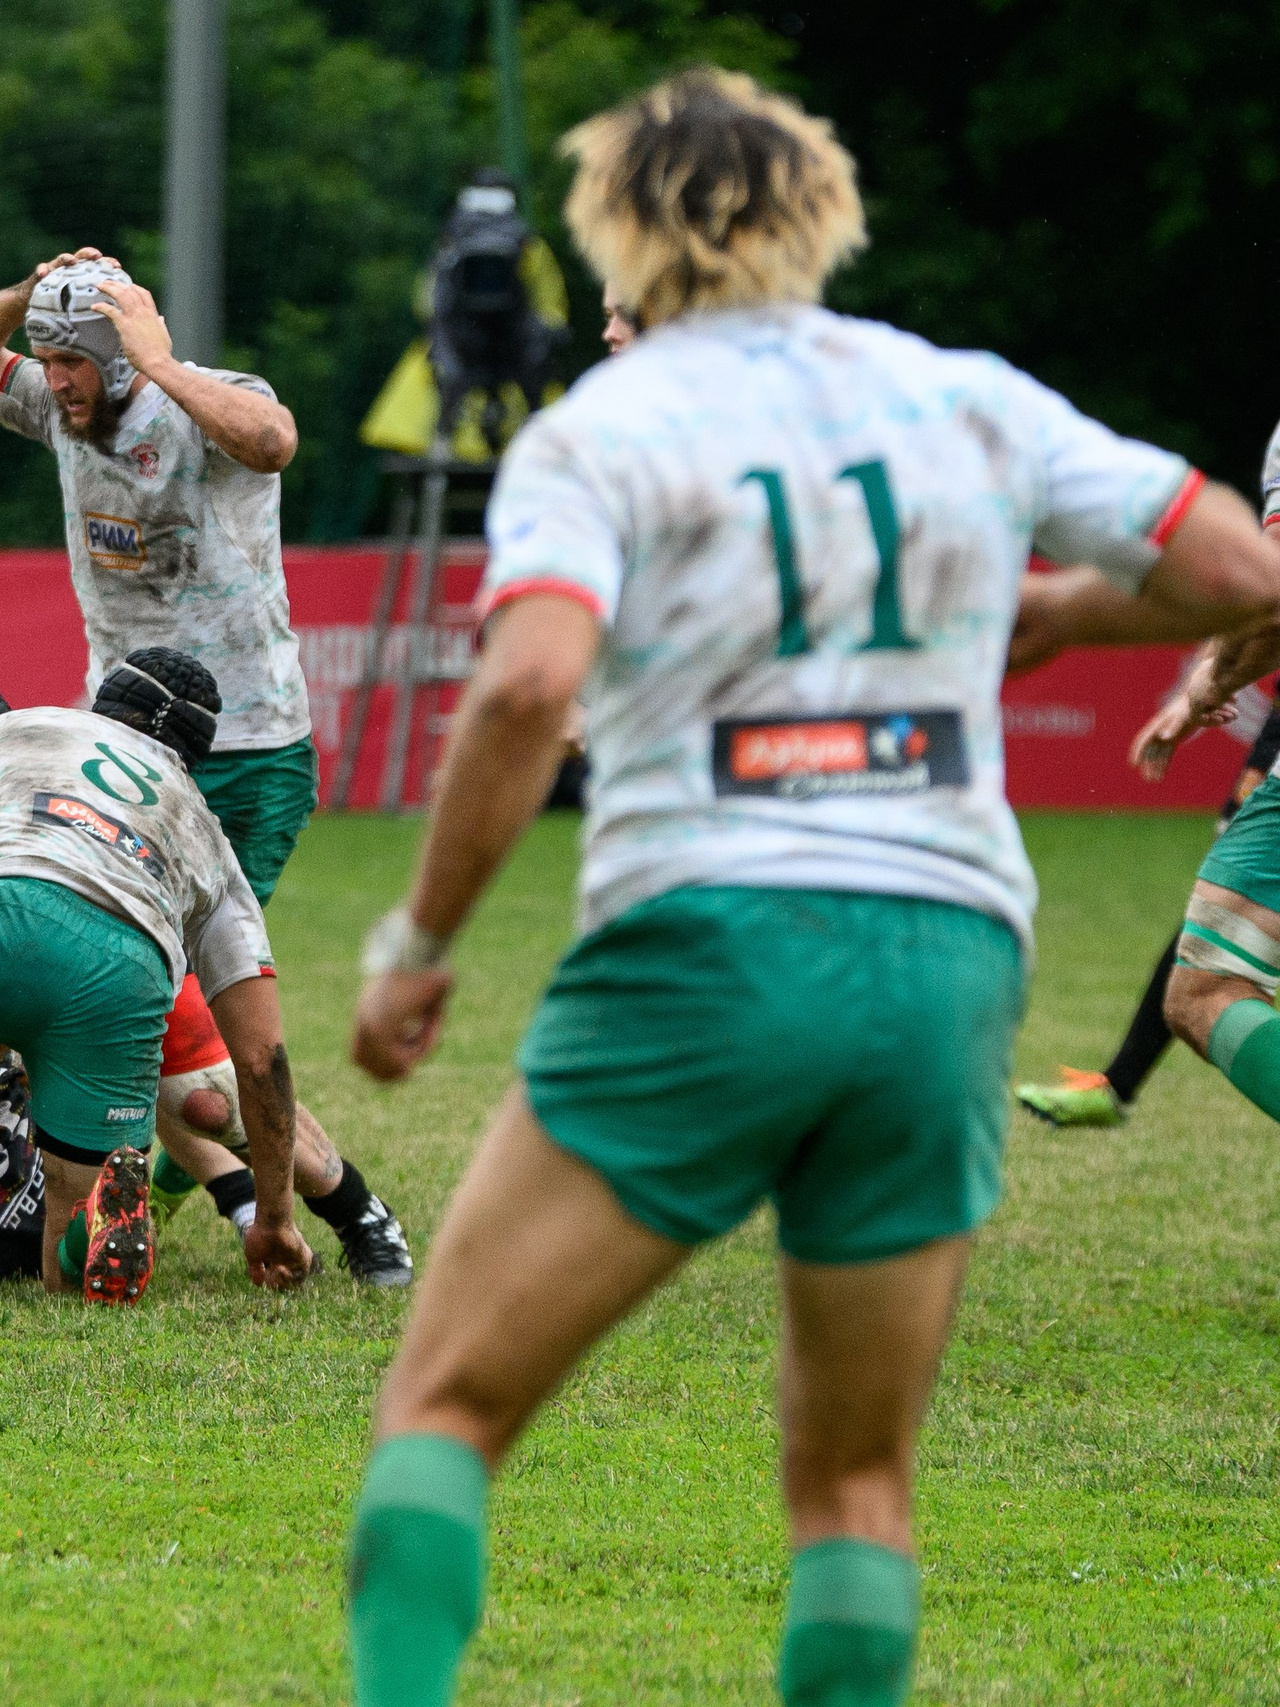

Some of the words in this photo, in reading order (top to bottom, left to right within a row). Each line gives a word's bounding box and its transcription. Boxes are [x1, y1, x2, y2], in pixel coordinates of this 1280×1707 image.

[738, 459, 922, 656] 11
[81, 742, 163, 806] 8
[55, 802, 115, 837] Азбука
